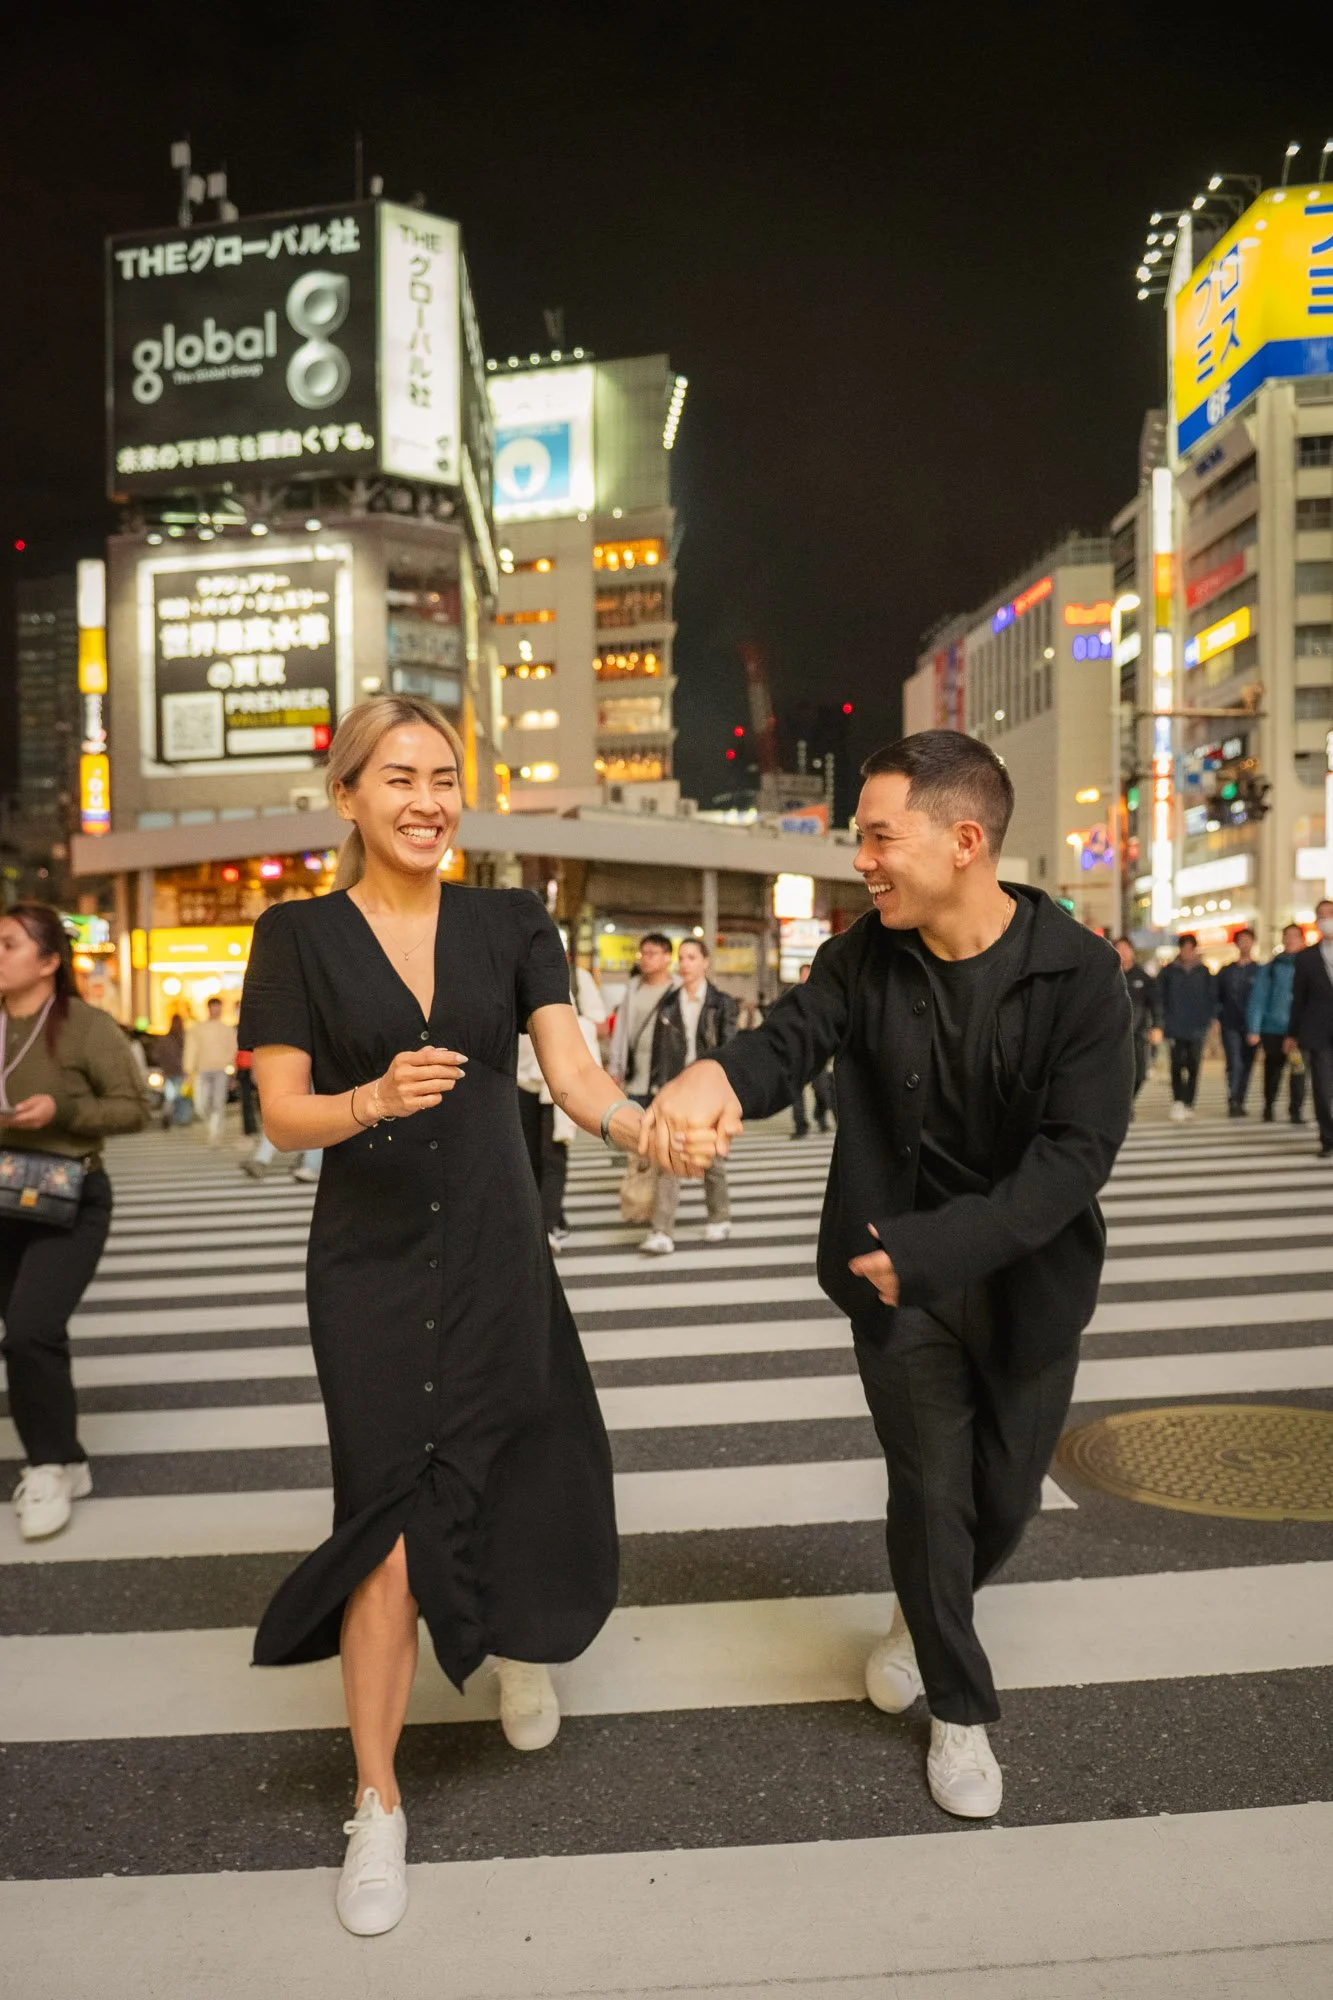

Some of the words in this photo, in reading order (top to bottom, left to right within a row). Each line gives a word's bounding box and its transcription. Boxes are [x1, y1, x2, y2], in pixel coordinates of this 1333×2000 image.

[115, 216, 360, 280] THEグローバル社
[132, 310, 277, 404] global
